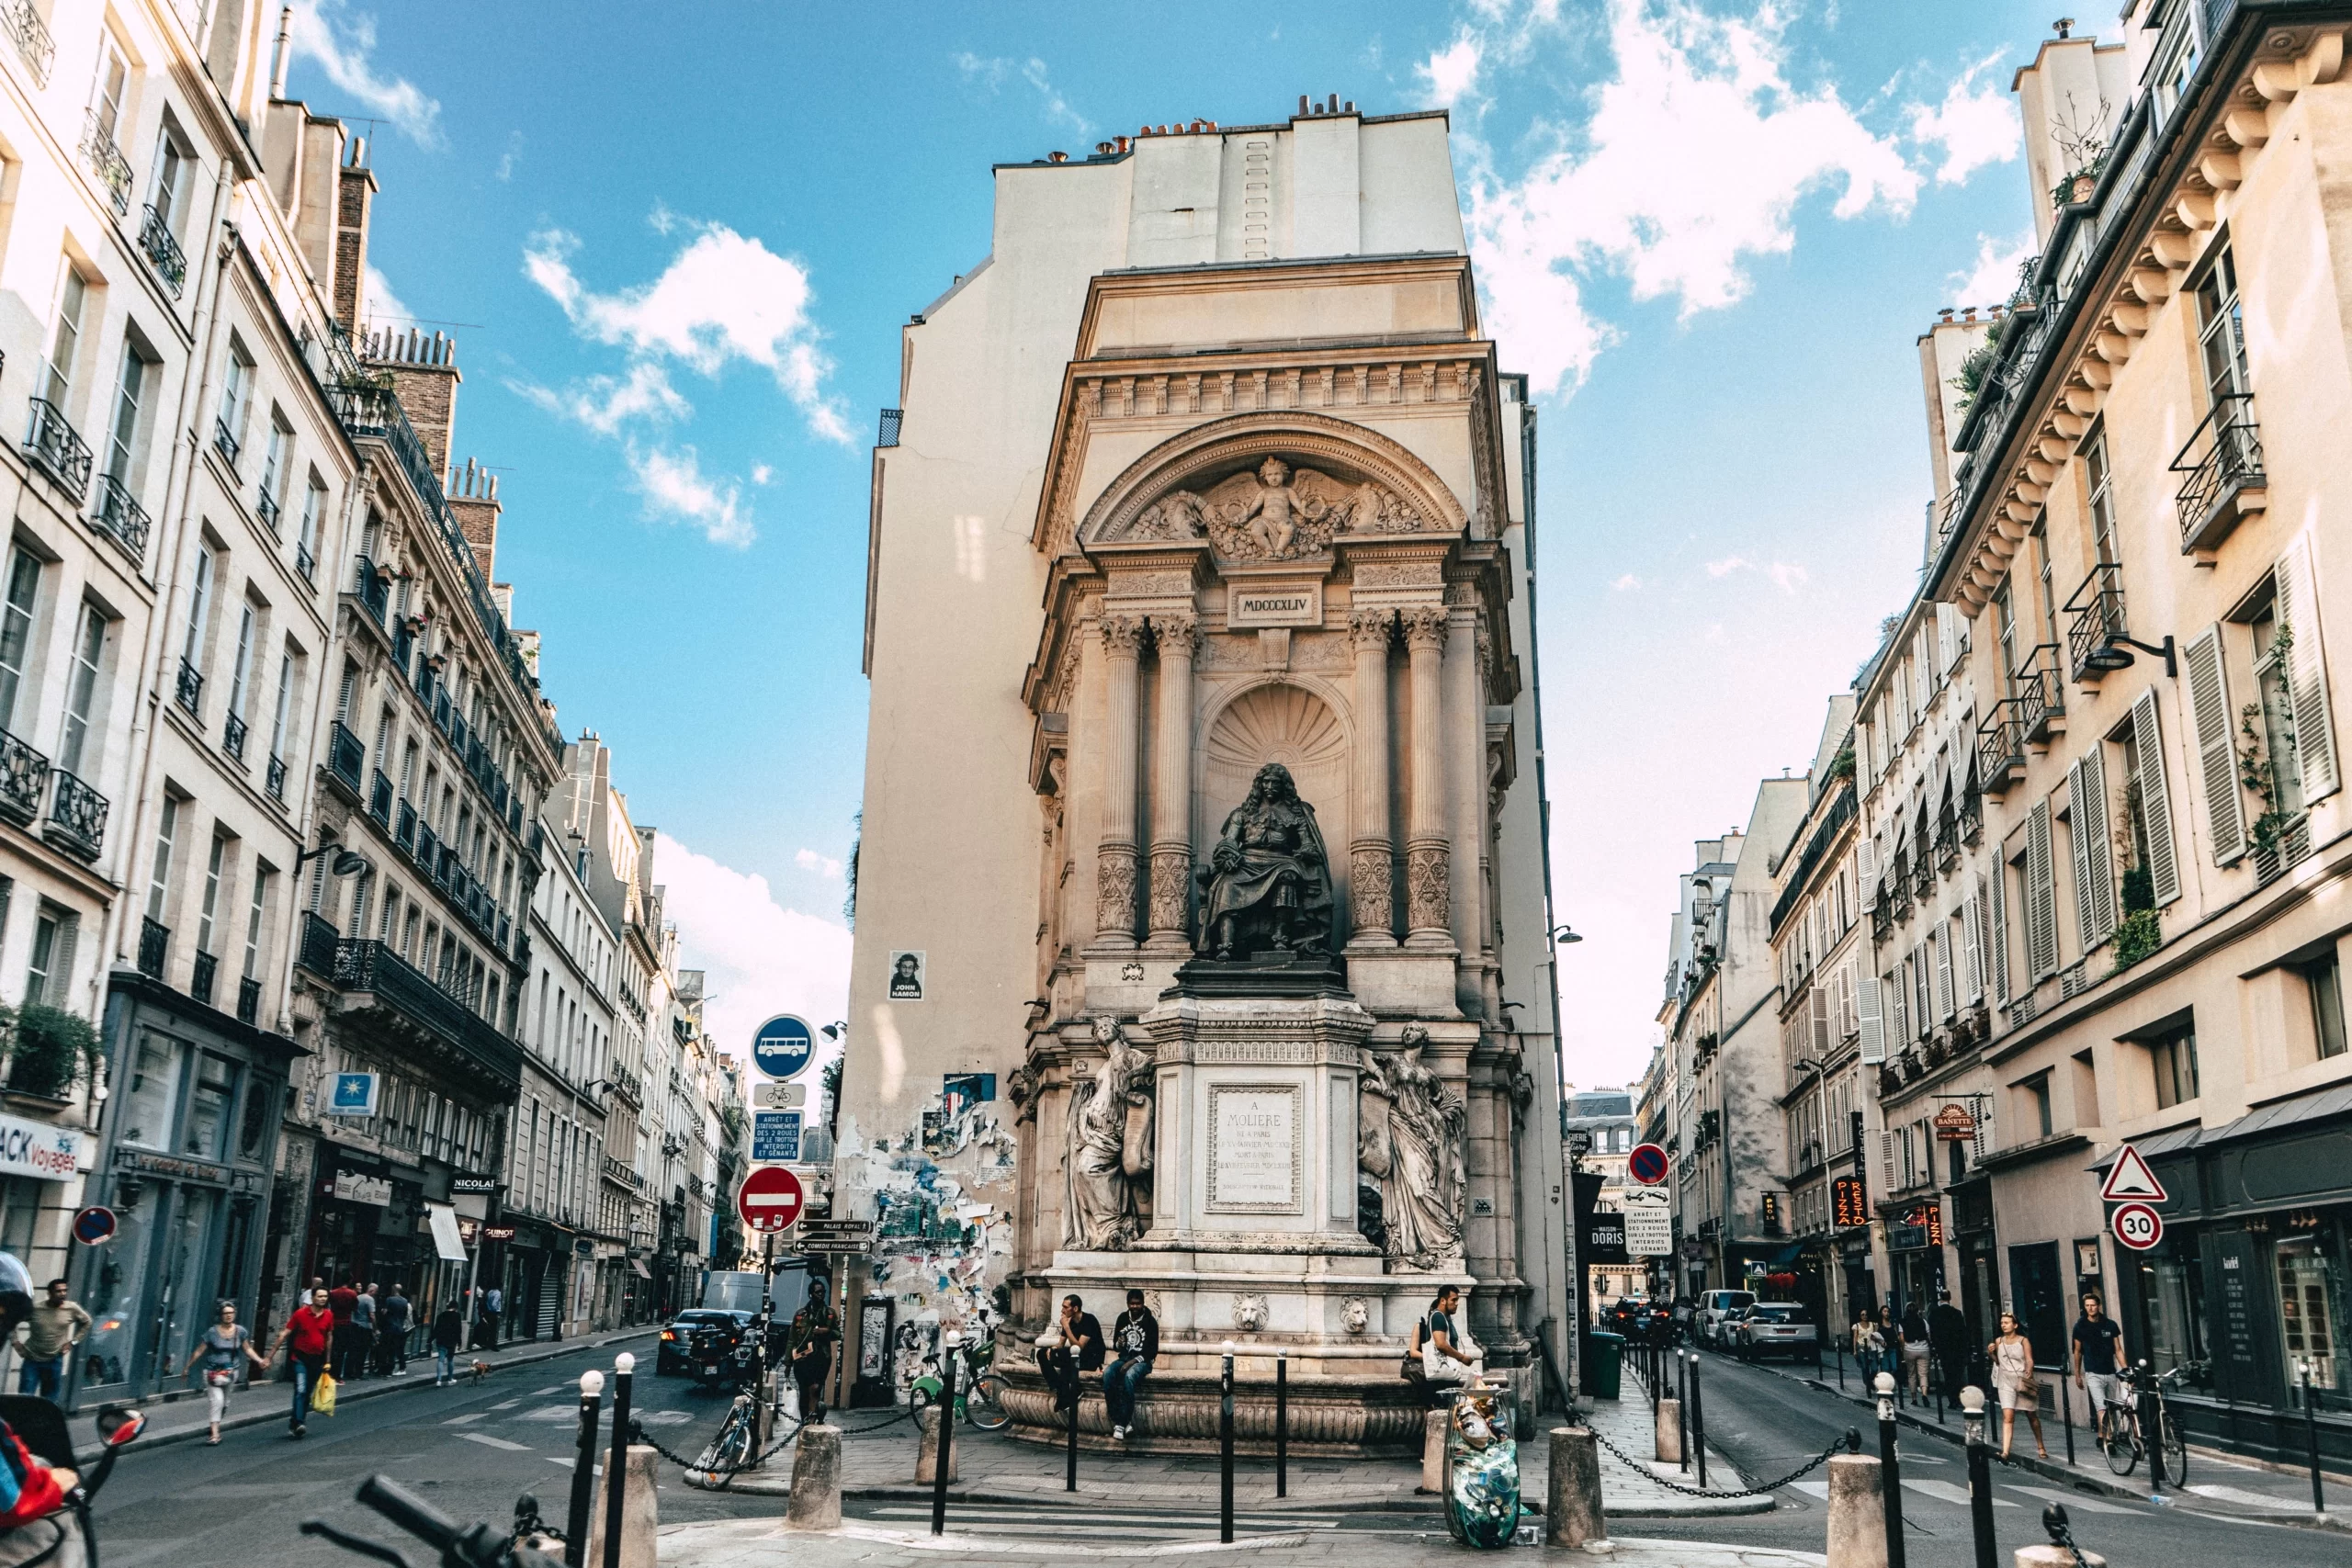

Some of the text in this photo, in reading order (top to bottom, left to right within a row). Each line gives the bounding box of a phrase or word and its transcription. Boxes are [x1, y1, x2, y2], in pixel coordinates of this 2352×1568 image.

[1243, 598, 1306, 612] MDCCCXLIV
[1250, 1101, 1259, 1111] A
[1227, 1114, 1281, 1127] MOLIERE
[1858, 1121, 1866, 1163] HOTEL
[31, 1144, 76, 1174] Voyages
[768, 1148, 797, 1157] GÊNANTS
[1838, 1181, 1850, 1224] PIZZA
[1851, 1181, 1865, 1225] RESTO
[485, 1228, 514, 1236] GUINOT
[1929, 1207, 1941, 1246] PIZZA
[2124, 1217, 2151, 1235] 30
[1592, 1233, 1623, 1245] DORIS
